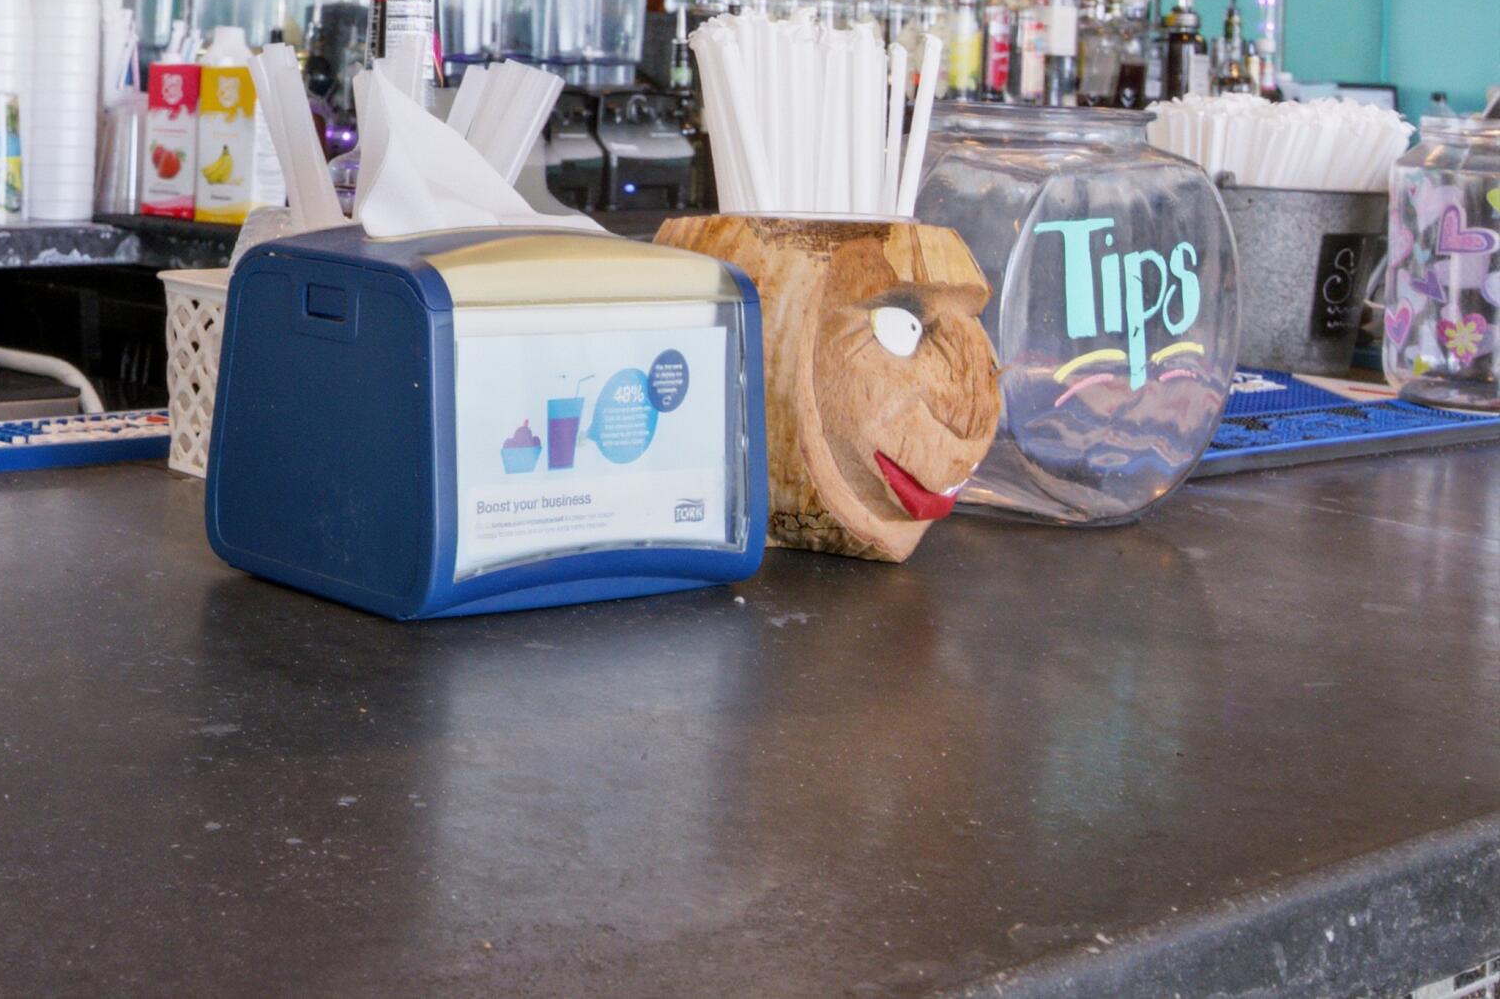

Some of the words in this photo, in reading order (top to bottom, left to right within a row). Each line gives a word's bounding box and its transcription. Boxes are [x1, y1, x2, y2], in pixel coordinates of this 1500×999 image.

[1032, 216, 1202, 392] Tips
[613, 384, 645, 404] 48%
[476, 500, 511, 515] Boost
[512, 498, 539, 516] your
[541, 493, 593, 510] business
